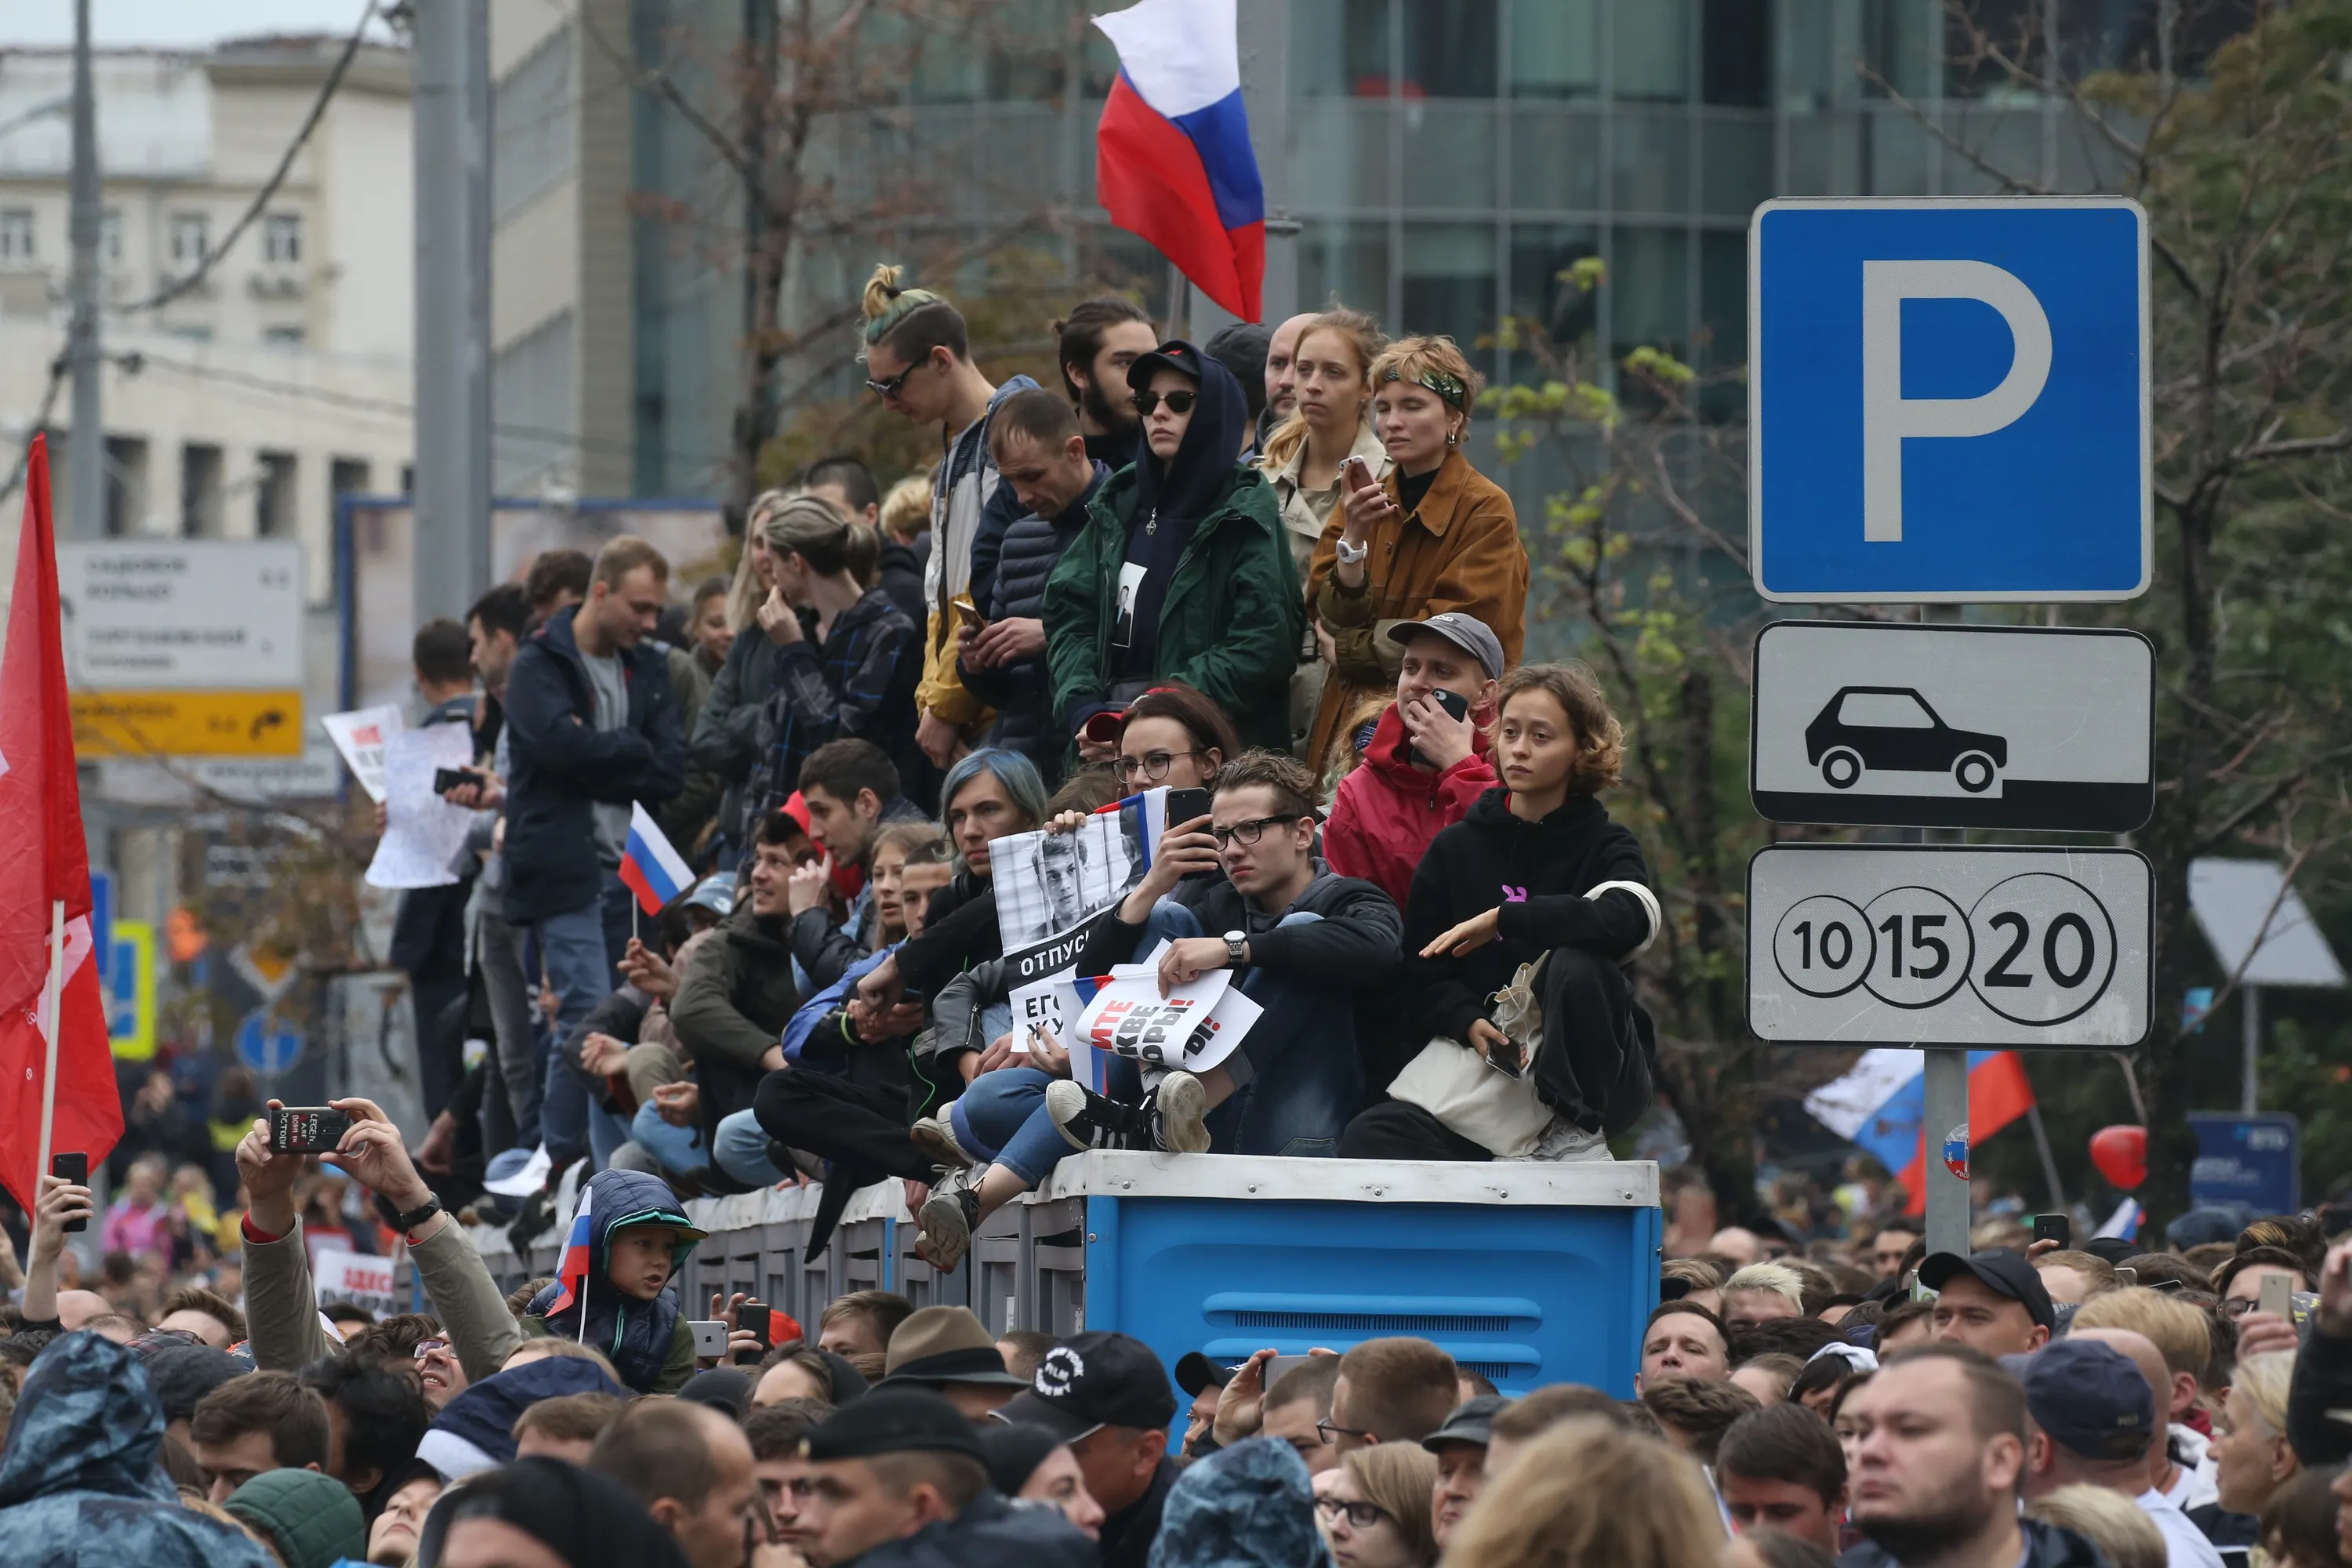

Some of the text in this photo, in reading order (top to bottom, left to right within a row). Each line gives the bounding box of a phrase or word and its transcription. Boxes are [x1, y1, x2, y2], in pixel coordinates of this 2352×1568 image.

[1863, 260, 2053, 543] P
[1792, 912, 2095, 988] 10 15 20
